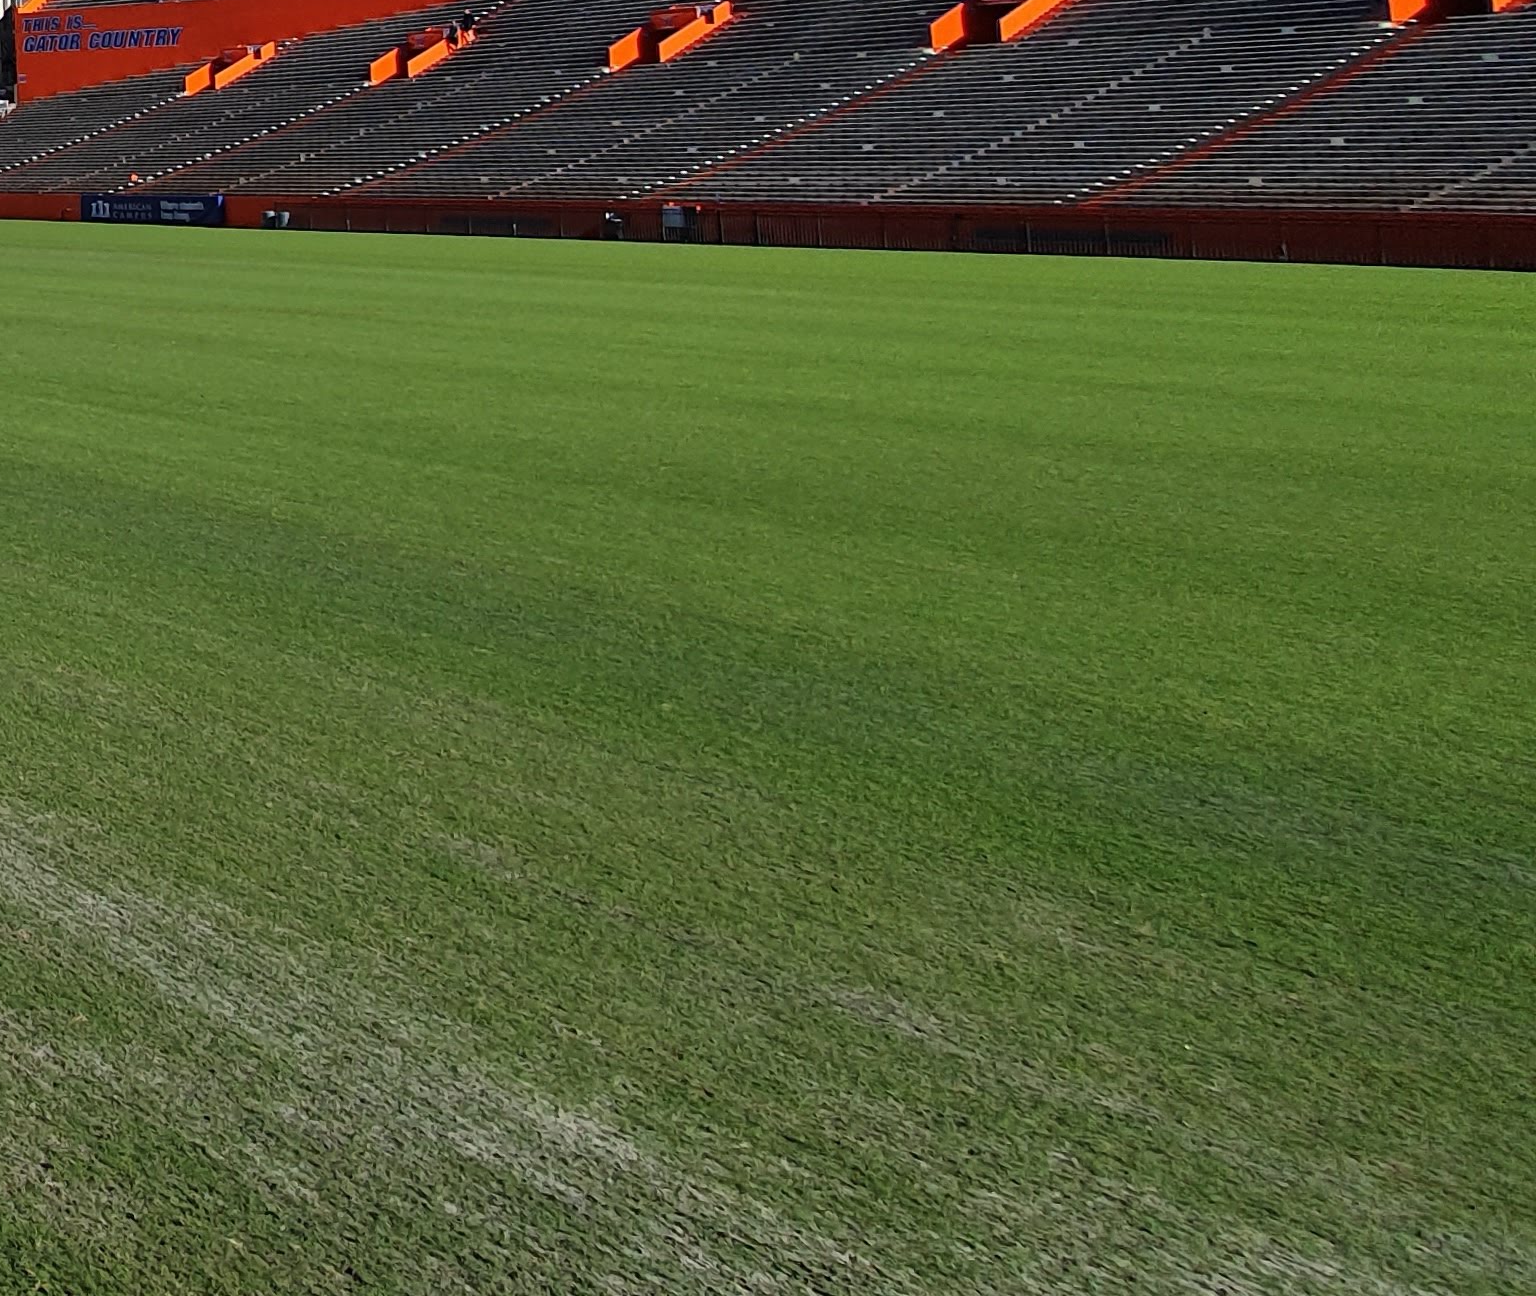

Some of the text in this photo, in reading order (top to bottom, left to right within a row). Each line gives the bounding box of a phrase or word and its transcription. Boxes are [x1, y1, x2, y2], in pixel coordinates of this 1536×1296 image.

[22, 17, 61, 33] THIS
[22, 26, 184, 54] GATOR COUNTRY
